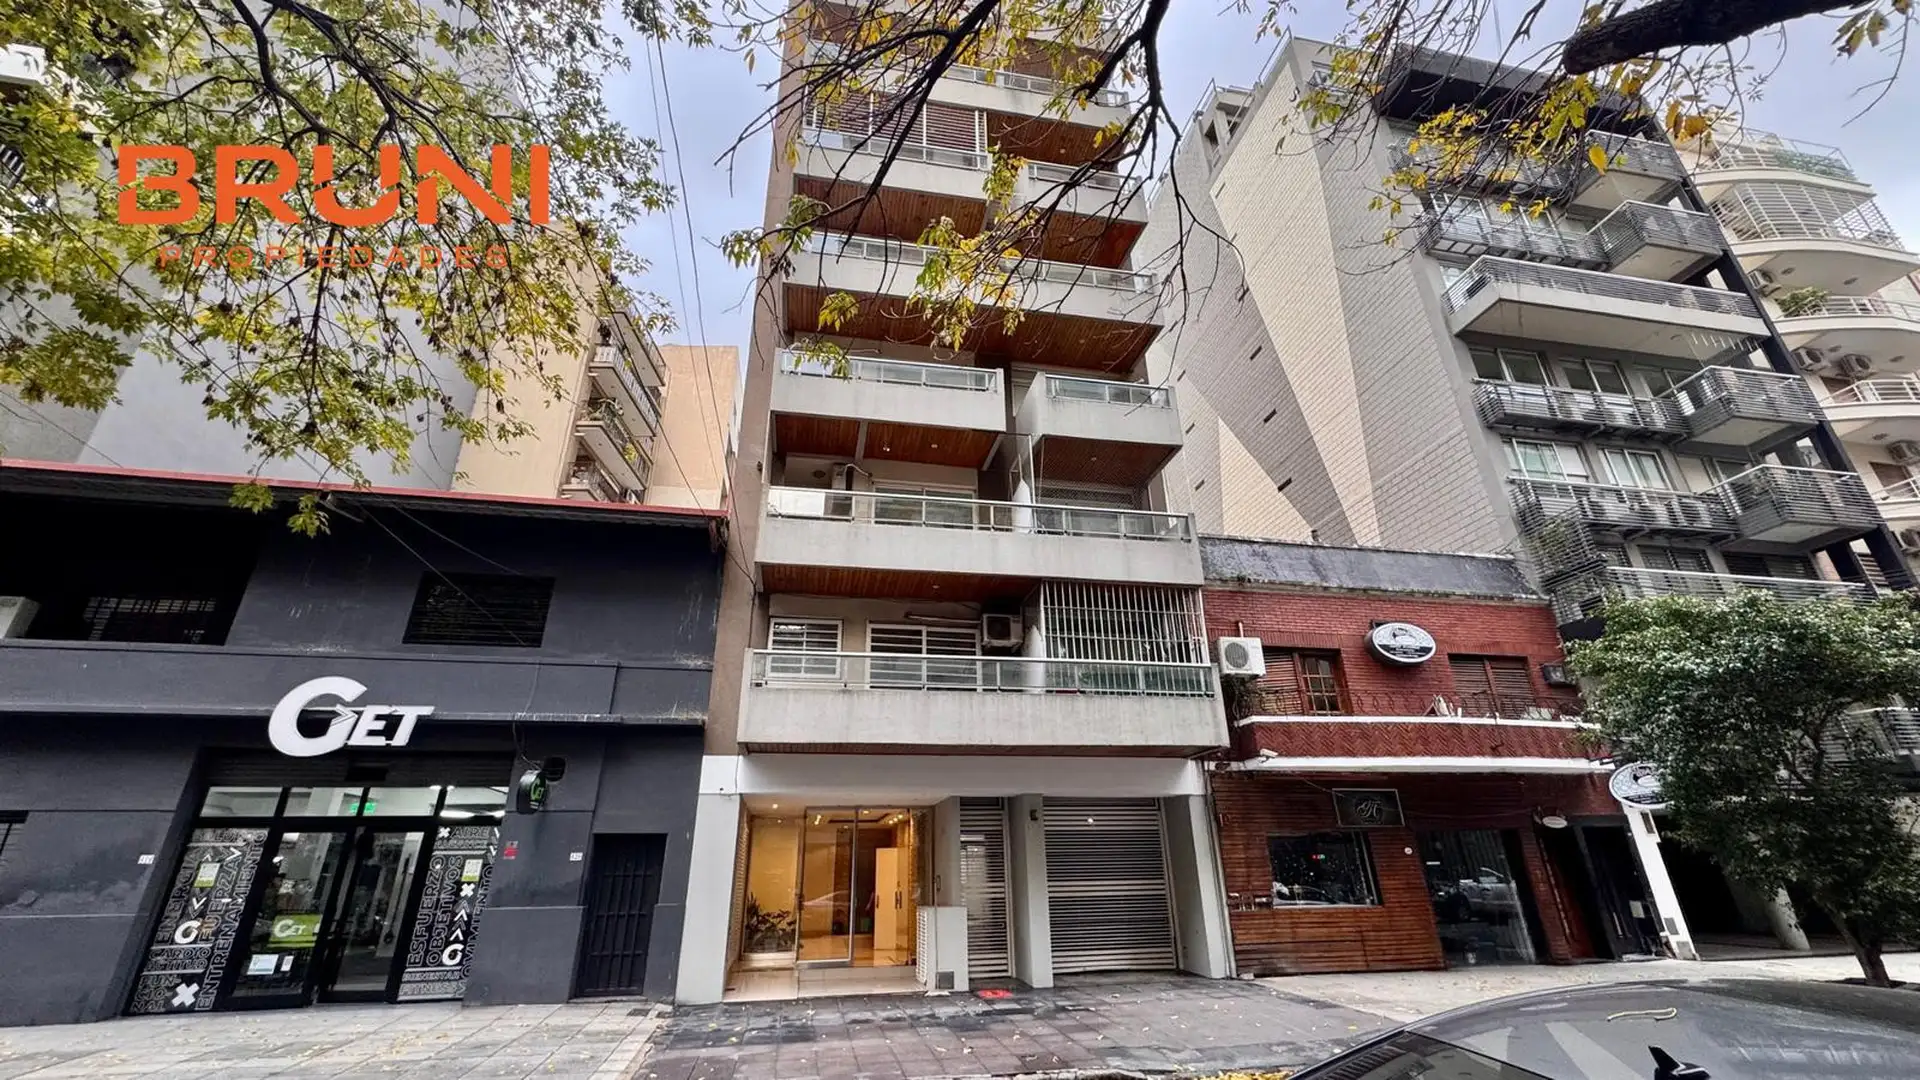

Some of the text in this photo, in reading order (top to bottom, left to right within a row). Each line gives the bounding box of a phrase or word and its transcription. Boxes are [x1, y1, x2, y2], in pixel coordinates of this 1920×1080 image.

[268, 676, 435, 757] GET
[195, 829, 267, 1010] ENTRENAMIENTO
[198, 857, 242, 944] FUERZA
[407, 855, 446, 966] ESFUERZO
[427, 856, 463, 966] OBJETIVOS
[149, 947, 212, 960] CARDIO
